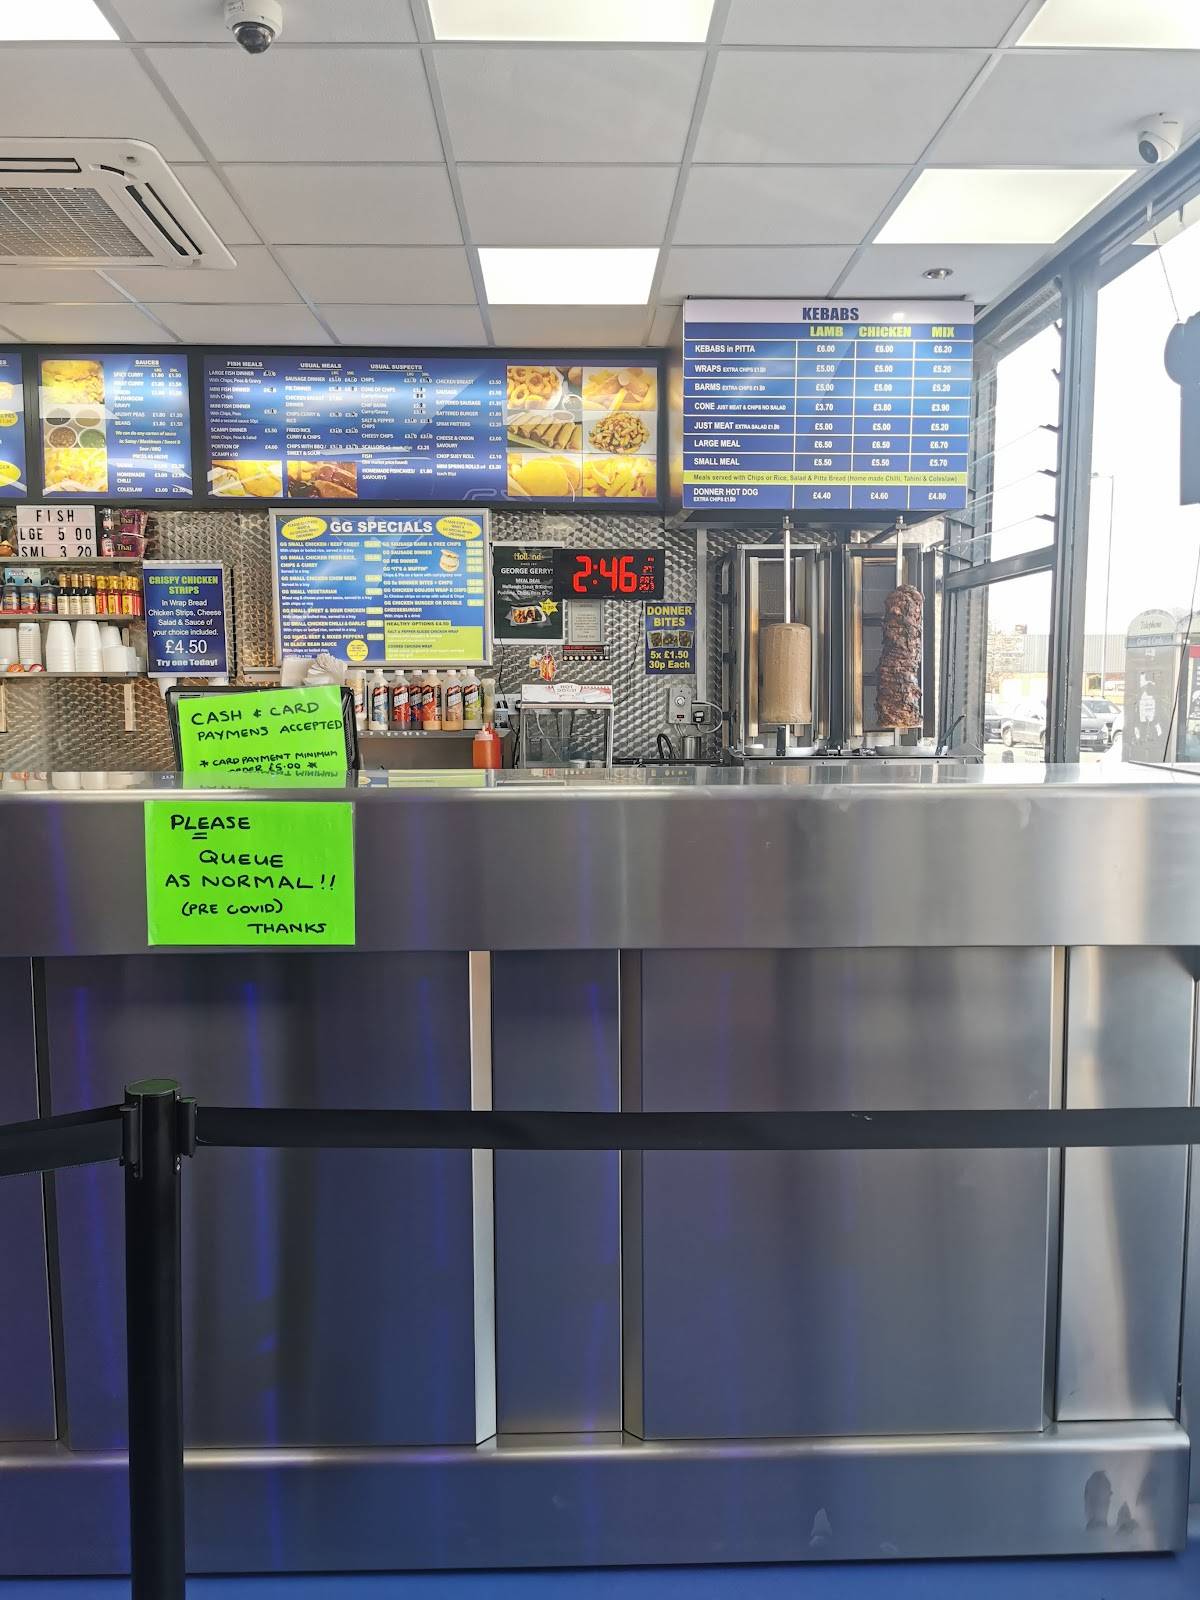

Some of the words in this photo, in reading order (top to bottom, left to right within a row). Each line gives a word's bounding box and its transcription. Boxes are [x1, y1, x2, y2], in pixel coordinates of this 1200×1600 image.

[802, 307, 859, 321] KEBABS
[810, 326, 843, 337] LAMB
[859, 326, 912, 337] CHICKEN
[931, 327, 955, 338] MIX
[695, 345, 726, 353] KEBABS
[727, 345, 733, 353] in
[735, 345, 755, 353] PITTA
[816, 345, 835, 353] £6.00
[875, 345, 894, 353] £6.00
[694, 365, 721, 373] WRAPS
[874, 365, 893, 373] £5.00
[933, 365, 951, 373] £5.20
[694, 383, 721, 391] BARMS
[874, 384, 893, 392] £5.00
[932, 384, 951, 392] £5.20
[694, 402, 715, 410] CONE
[815, 403, 834, 411] £3.70
[694, 422, 713, 430] JUST
[714, 422, 734, 430] MEAT
[815, 423, 833, 431] £5.00
[872, 423, 891, 431] £5.00
[931, 423, 949, 431] £5.20
[720, 440, 741, 448] MEAL
[814, 441, 833, 449] £6.50
[872, 441, 891, 449] £6.50
[930, 441, 948, 449] £6.70
[693, 458, 719, 466] SMALL
[720, 458, 740, 466] MEAL
[813, 459, 832, 467] £5.50
[871, 459, 890, 467] £5.50
[929, 459, 948, 467] £5.70
[747, 474, 765, 483] Chips
[693, 488, 725, 496] DONNER
[725, 488, 740, 496] HOT
[742, 488, 758, 496] DOG
[813, 492, 831, 500] £4.40
[870, 492, 889, 500] £4.60
[36, 509, 74, 523] FISH
[329, 521, 353, 533] GG
[357, 521, 433, 533] SPECIALS
[20, 528, 43, 541] LGE
[21, 546, 46, 557] SML
[500, 567, 528, 575] GEORGE
[572, 555, 637, 593] 2:46
[148, 576, 179, 585] CRISPY
[181, 576, 218, 585] CHICKEN
[168, 586, 200, 595] STRIPS
[169, 599, 187, 608] Wrap
[175, 609, 196, 617] Strips,
[647, 606, 693, 616] DONNER
[653, 618, 686, 627] BITES
[168, 628, 189, 636] choice
[190, 628, 219, 636] included.
[165, 639, 208, 654] £4.50
[650, 651, 661, 659] 5x
[664, 650, 689, 659] £1.50
[156, 659, 171, 667] Try
[189, 659, 218, 667] Today!
[649, 660, 665, 670] 30p
[667, 660, 690, 669] Each
[191, 709, 242, 725] CASH
[270, 702, 320, 716] CARD
[197, 726, 269, 742] PAYMENS
[279, 720, 343, 734] ACCEPTED
[213, 758, 239, 767] CARD
[242, 753, 291, 764] PAYMENT
[295, 750, 338, 760] MINIMUM
[170, 814, 251, 830] PLEASE
[199, 849, 284, 868] QUEUE
[165, 873, 191, 888] AS
[182, 901, 218, 917] (PRE
[226, 898, 283, 915] COVID)
[247, 923, 327, 934] THANKS
